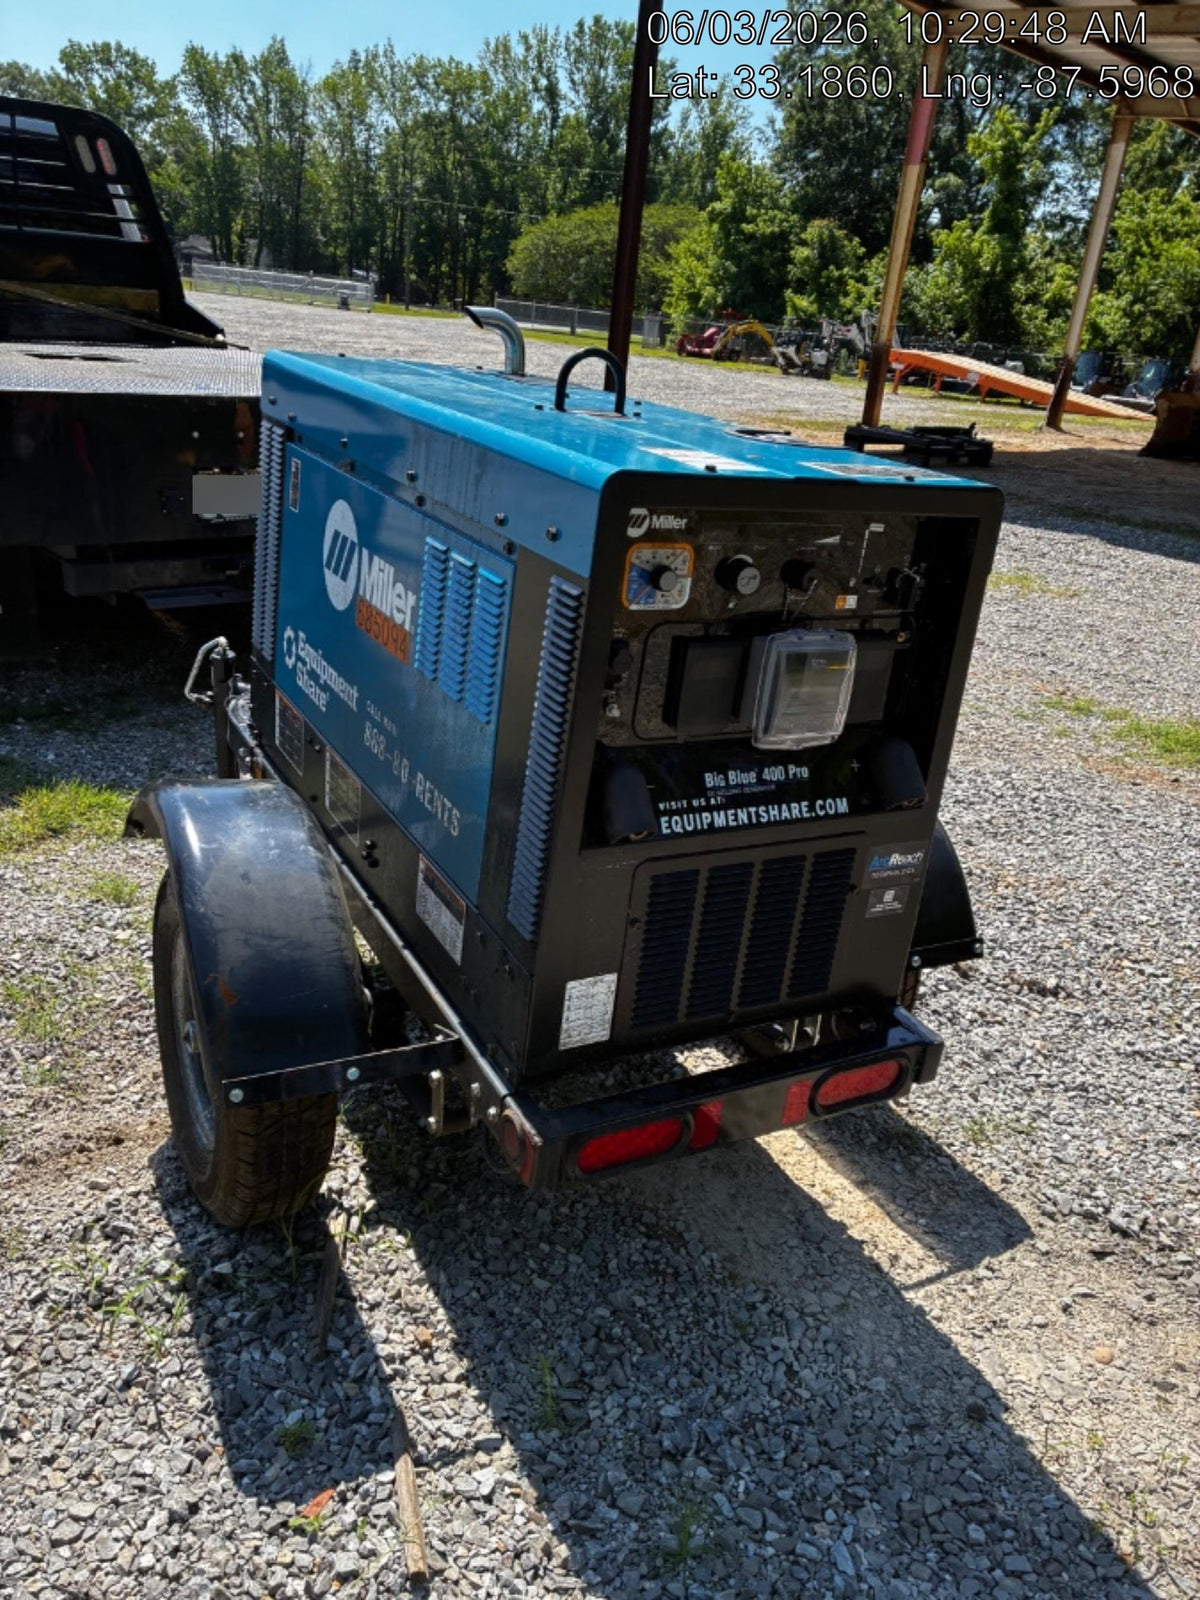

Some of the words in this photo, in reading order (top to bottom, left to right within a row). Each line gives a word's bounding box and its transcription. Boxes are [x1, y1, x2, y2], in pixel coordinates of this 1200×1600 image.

[651, 514, 688, 530] Miller
[359, 546, 417, 632] Miller
[296, 660, 327, 712] Share
[298, 629, 359, 712] Equipment
[704, 770, 726, 788] Big
[728, 768, 757, 785] Blue
[762, 765, 785, 782] 400
[788, 763, 809, 780] Pro
[658, 799, 687, 811] VISIT
[692, 798, 706, 807] US
[659, 797, 849, 835] EQUIPMENTSHARE.COM
